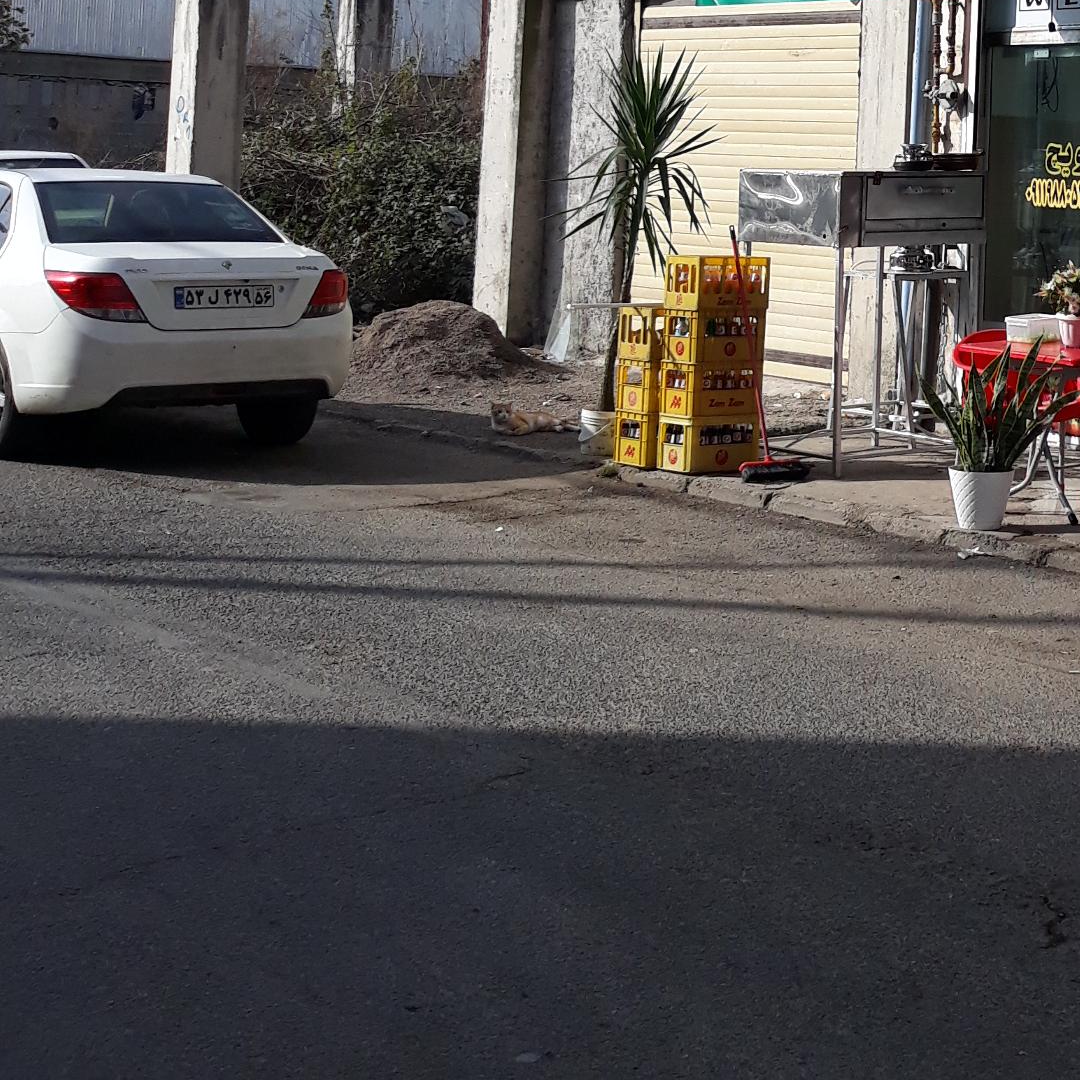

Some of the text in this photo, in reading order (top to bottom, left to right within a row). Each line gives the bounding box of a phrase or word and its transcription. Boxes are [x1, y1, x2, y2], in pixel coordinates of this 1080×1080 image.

[186, 288, 204, 305] ۵۳
[208, 288, 218, 305] ل
[255, 290, 271, 305] ۵۶
